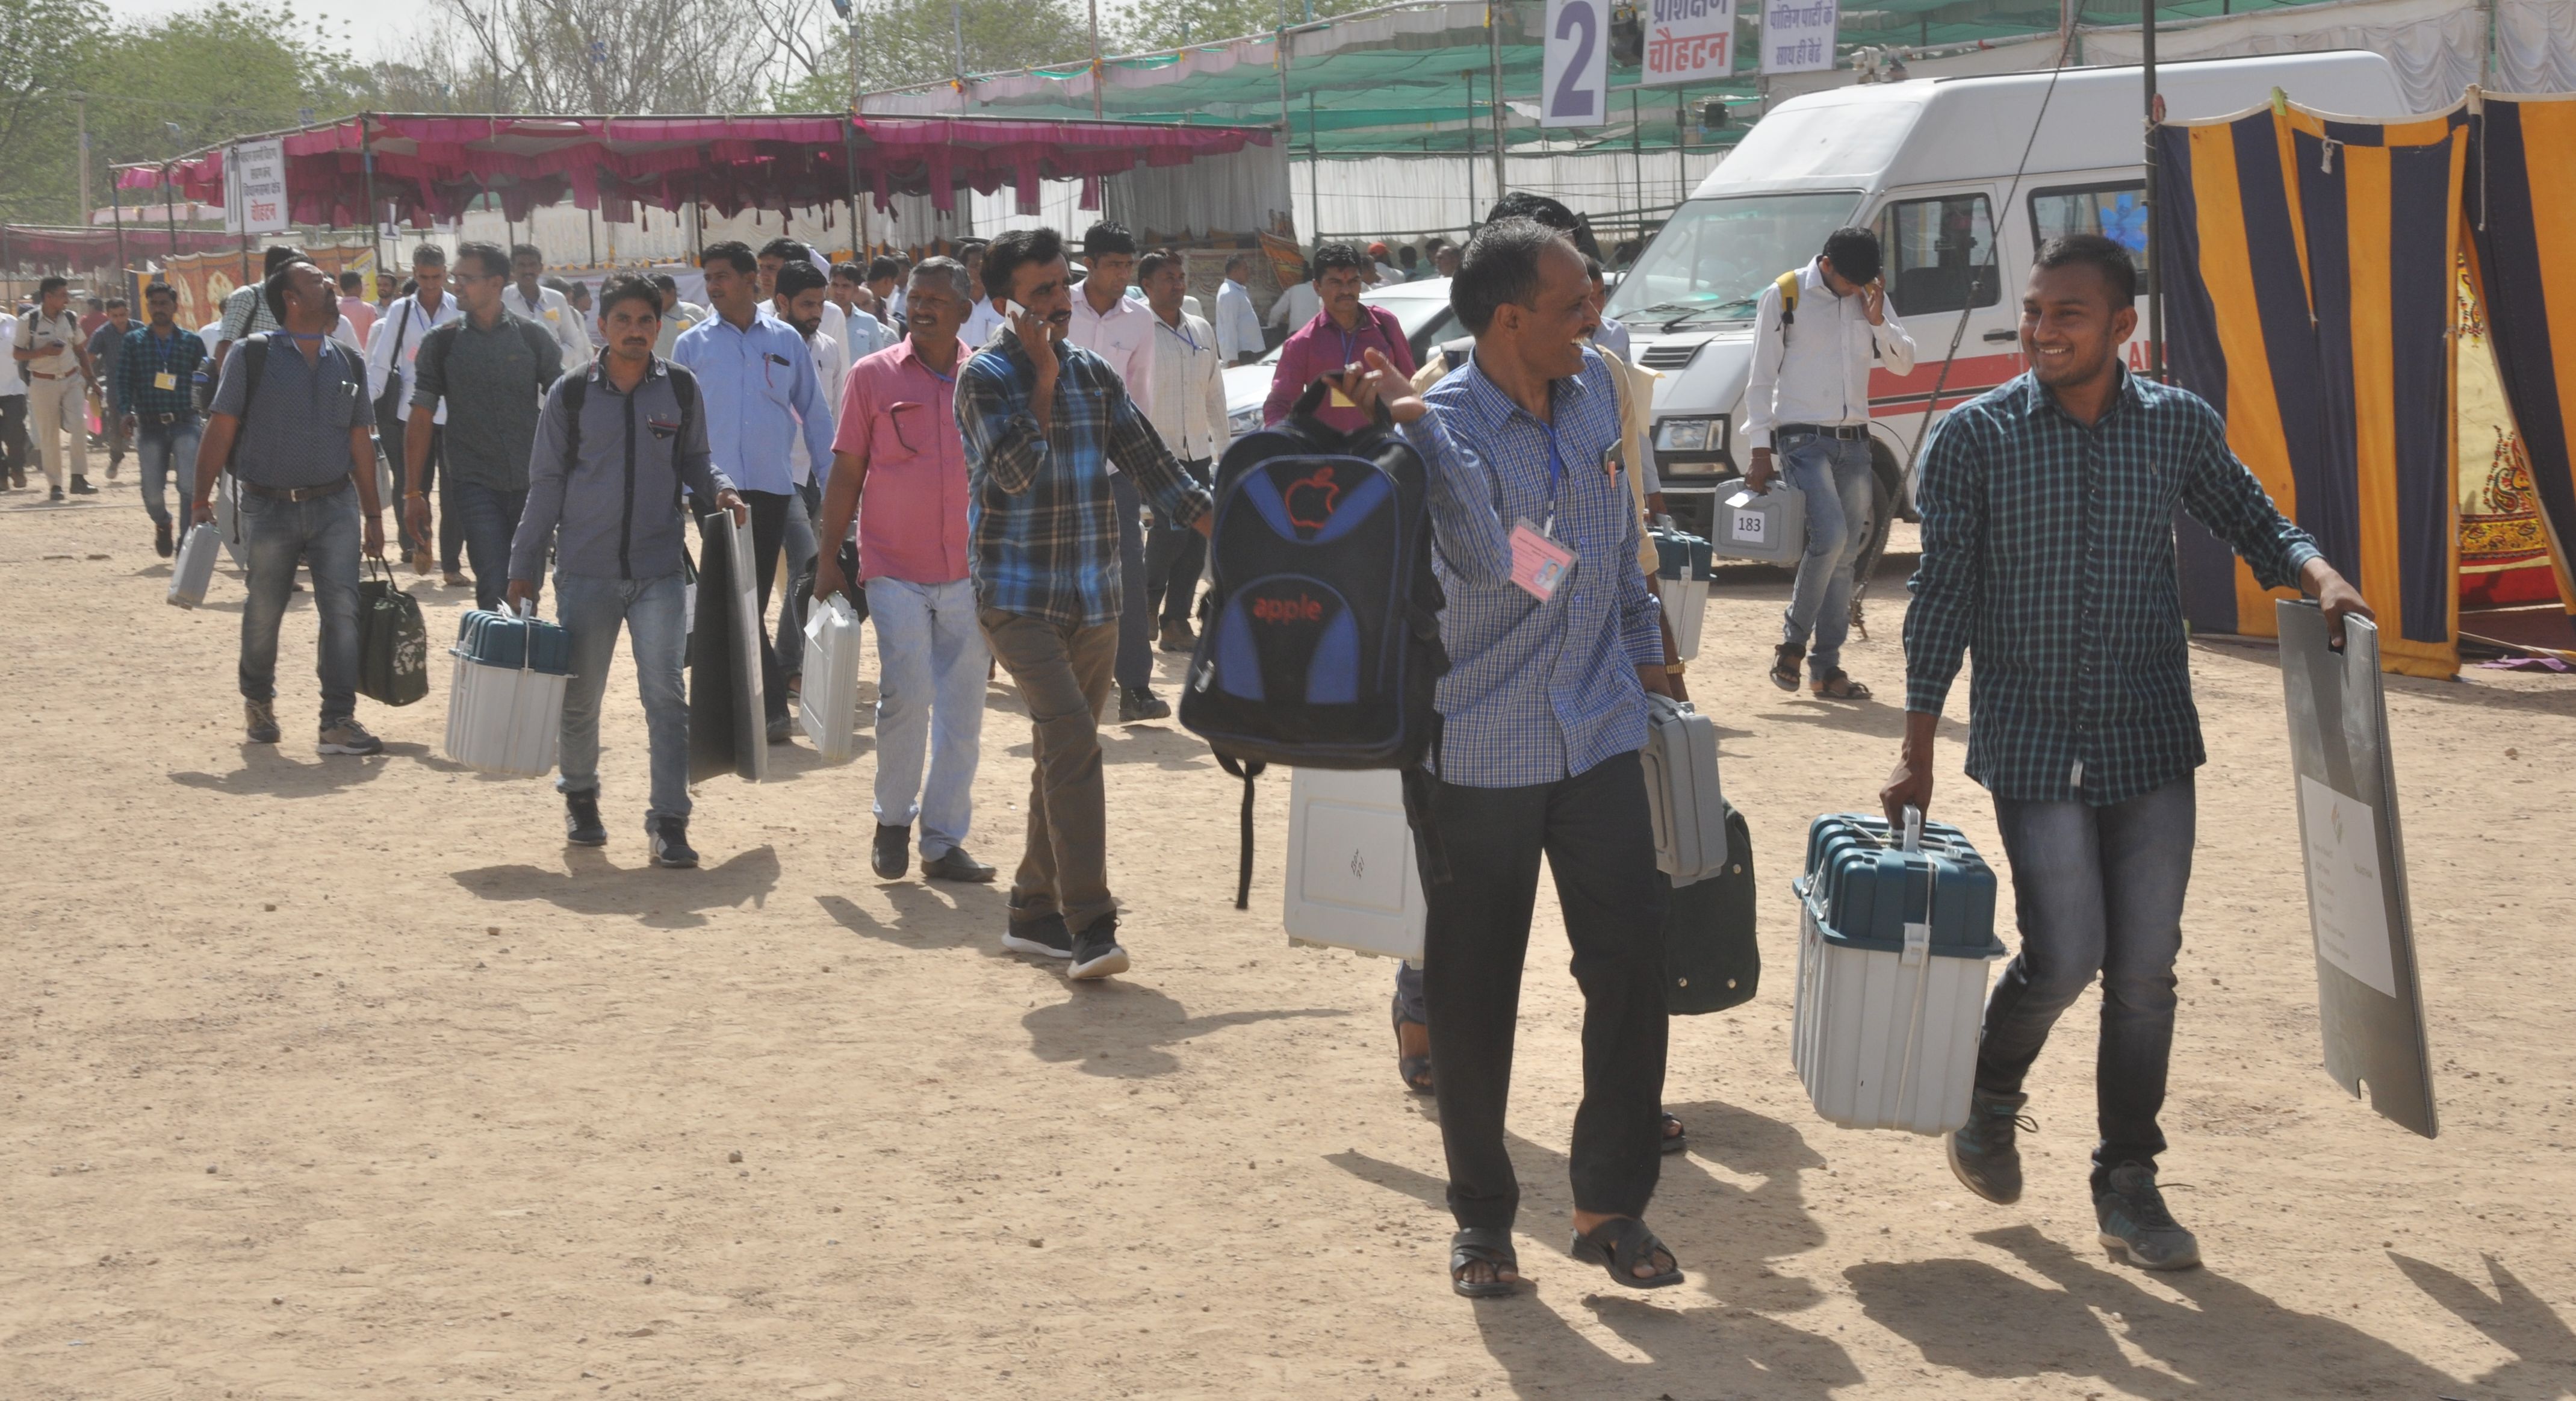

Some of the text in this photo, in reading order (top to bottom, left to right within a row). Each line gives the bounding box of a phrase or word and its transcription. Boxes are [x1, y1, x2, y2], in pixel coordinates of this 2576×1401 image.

[1550, 1, 1597, 117] 2
[1648, 27, 1729, 73] चौहटन
[1738, 517, 1761, 532] 183
[1253, 592, 1322, 626] apple
